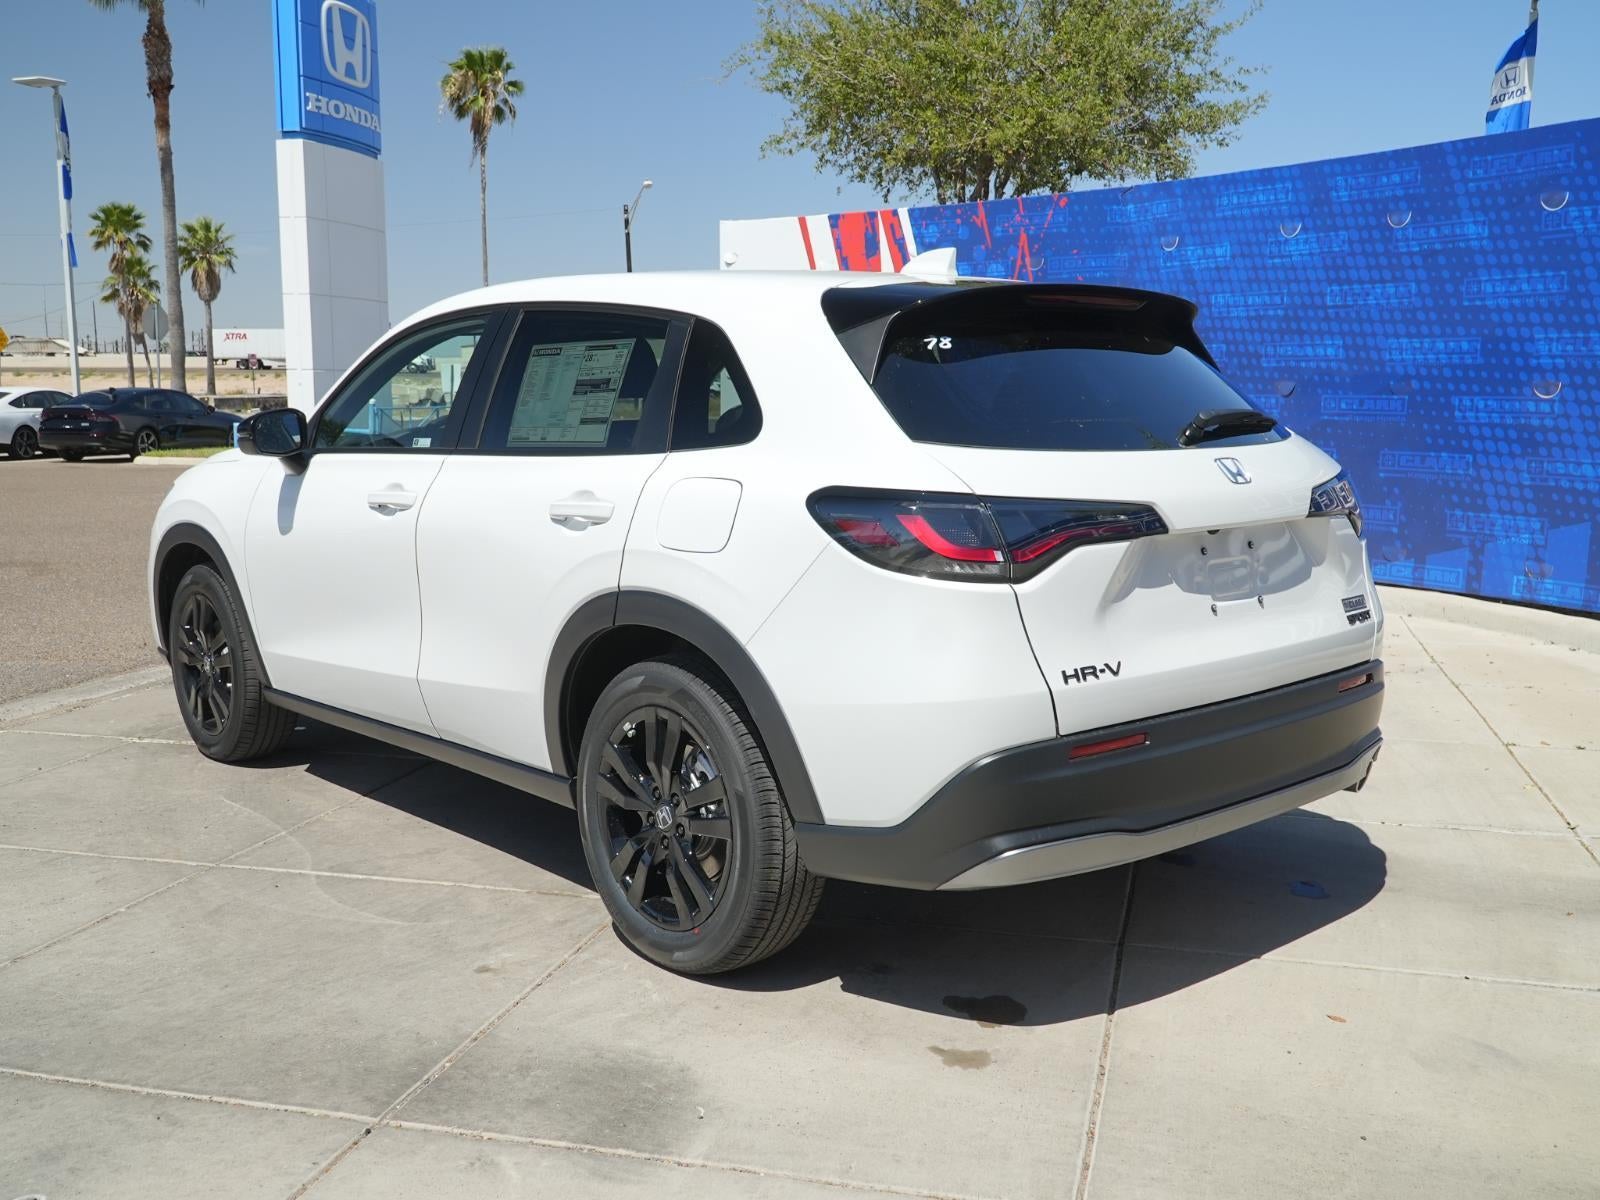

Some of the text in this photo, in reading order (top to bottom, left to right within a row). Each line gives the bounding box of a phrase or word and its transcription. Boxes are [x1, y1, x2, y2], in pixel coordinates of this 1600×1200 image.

[305, 91, 380, 133] HONDA
[224, 333, 247, 342] XTRA
[923, 336, 952, 350] 78
[1061, 661, 1121, 685] HR-V
